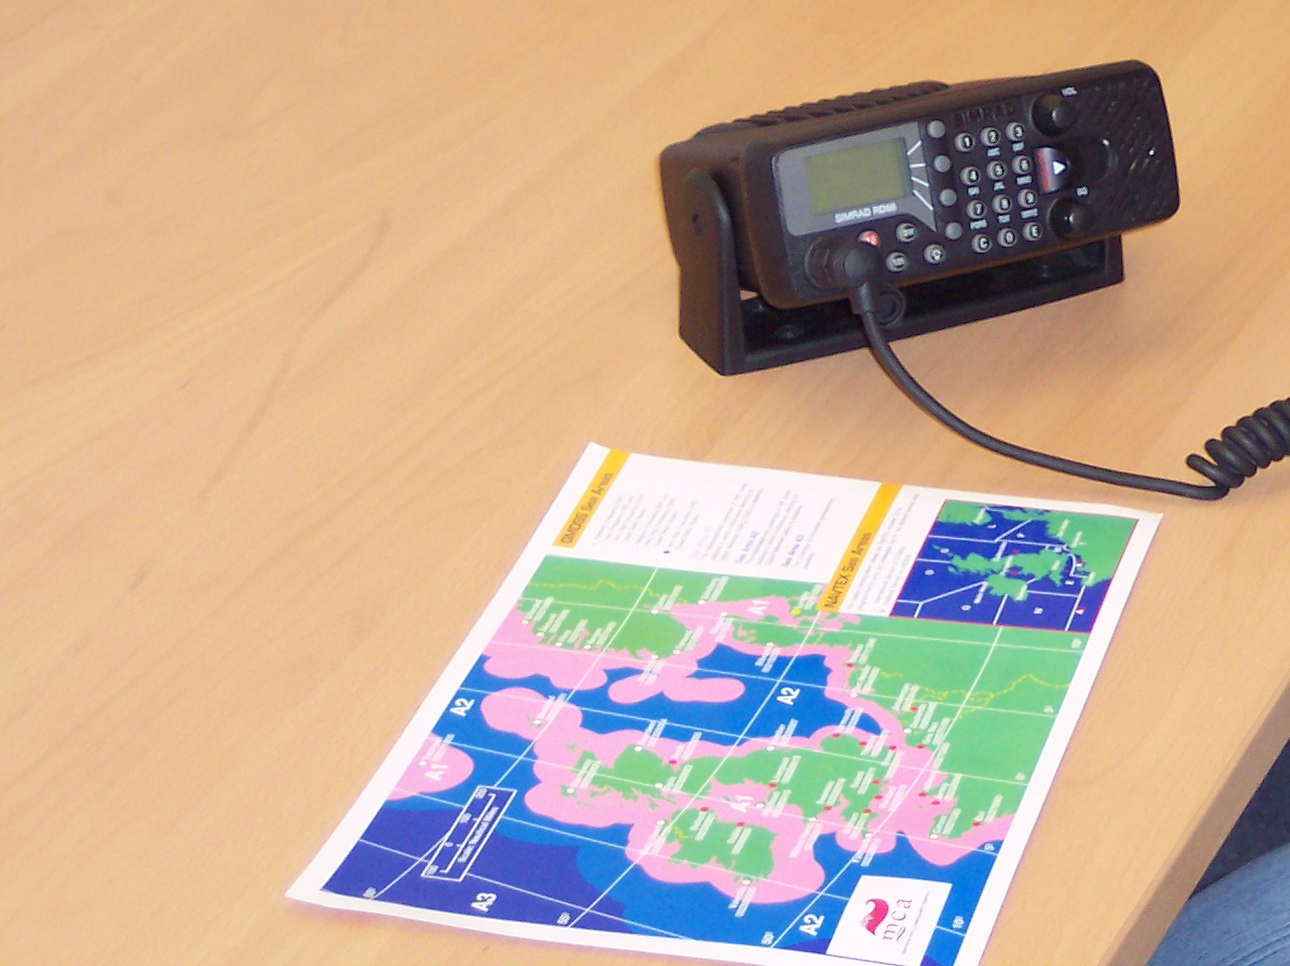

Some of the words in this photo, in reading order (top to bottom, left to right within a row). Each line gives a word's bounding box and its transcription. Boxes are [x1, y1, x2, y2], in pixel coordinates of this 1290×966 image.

[834, 207, 872, 223] SIMRAD
[560, 513, 588, 544] GMDSS
[824, 573, 849, 609] NAVTEX
[842, 557, 859, 572] Sea
[748, 599, 770, 616] A1
[776, 687, 800, 705] A2
[450, 697, 475, 717] A2
[424, 763, 449, 781] A1
[730, 795, 754, 812] A1
[471, 892, 498, 912] A3
[798, 913, 825, 937] A2
[882, 899, 912, 940] mca
